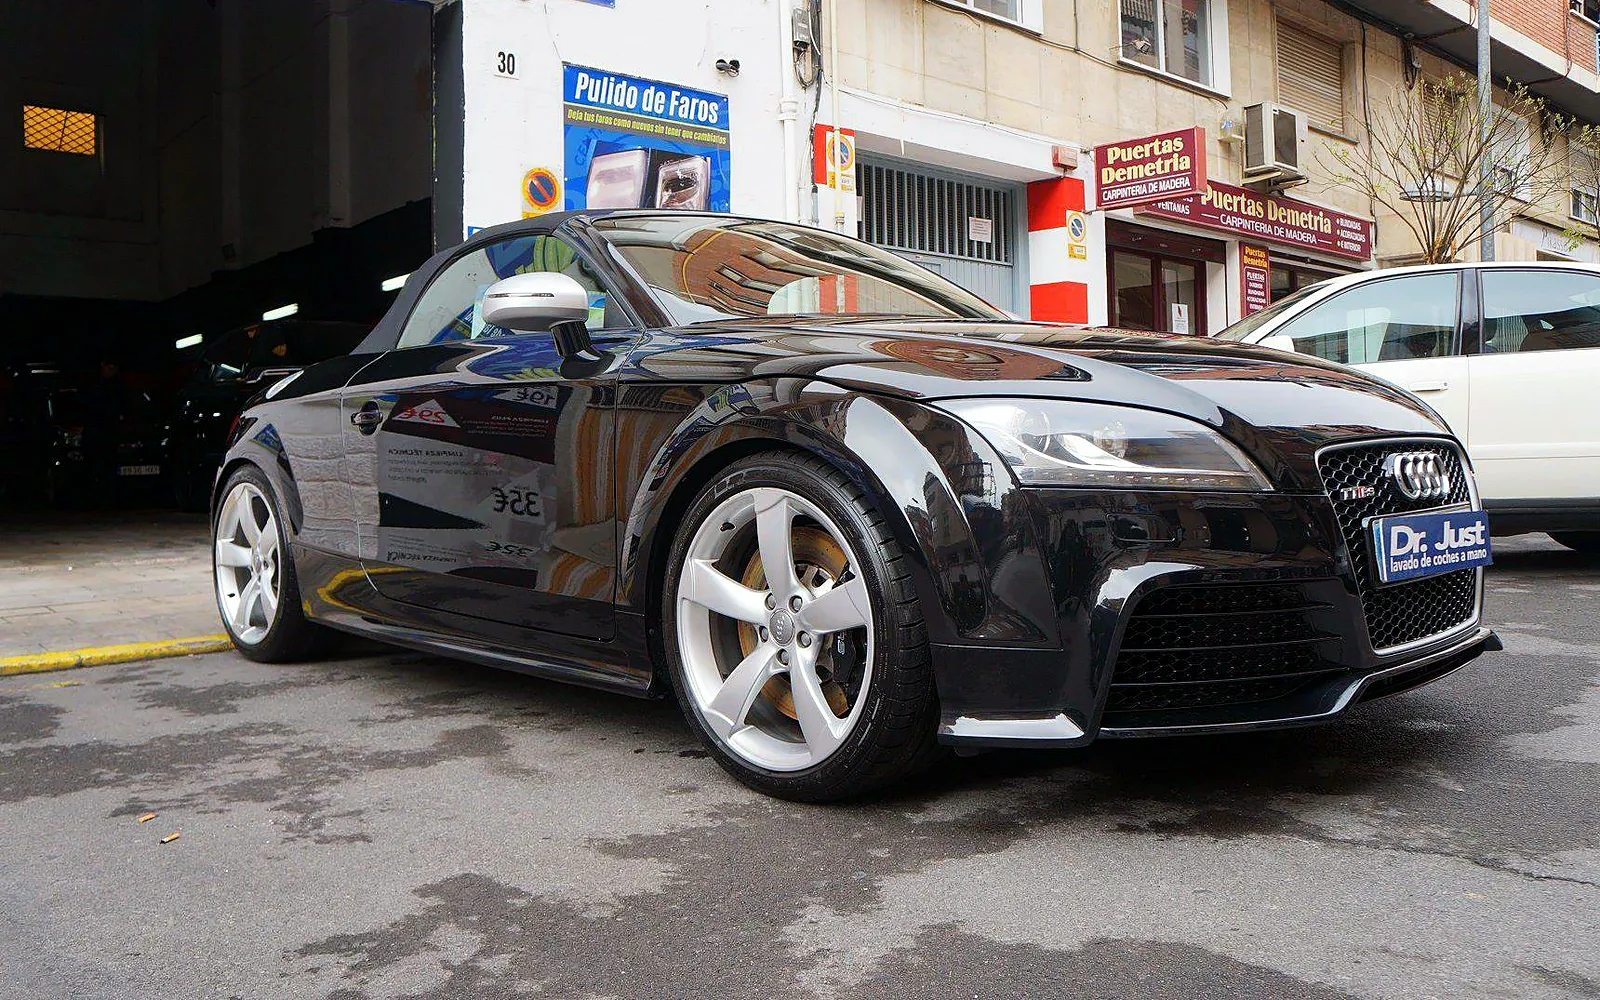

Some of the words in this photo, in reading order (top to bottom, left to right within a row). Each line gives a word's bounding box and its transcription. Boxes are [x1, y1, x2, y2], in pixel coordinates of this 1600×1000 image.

[497, 51, 515, 75] 30
[574, 72, 638, 110] Pulido
[641, 85, 665, 115] de
[668, 90, 719, 124] Faros
[567, 108, 583, 120] Deja
[584, 110, 595, 123] tus
[595, 113, 613, 125] faros
[613, 116, 631, 128] como
[631, 119, 654, 132] nuevos
[654, 122, 665, 134] sin
[665, 125, 681, 137] tener
[682, 129, 693, 140] que
[693, 131, 727, 145] cambiarlos
[1107, 137, 1184, 164] Puertas
[1101, 153, 1191, 184] Demetria
[1102, 185, 1148, 201] CARPINTERIA
[1148, 182, 1158, 193] DE
[1159, 176, 1190, 191] MADERA
[1200, 184, 1264, 218] Puertas
[1157, 201, 1190, 214] VENTANAS
[1267, 199, 1332, 234] Demetria
[1220, 213, 1273, 234] CARPINTERIA
[1274, 225, 1285, 238] DE
[1285, 227, 1317, 244] MADERA
[1243, 255, 1268, 268] Demetria
[1245, 246, 1266, 258] Puertas
[1246, 271, 1265, 281] PUERTAS
[1390, 525, 1428, 556] Dr.
[1434, 520, 1486, 551] Just
[1390, 556, 1419, 573] lavado
[1420, 552, 1432, 568] de
[1433, 549, 1459, 566] coches
[1460, 551, 1466, 560] a
[1466, 548, 1488, 561] mano
